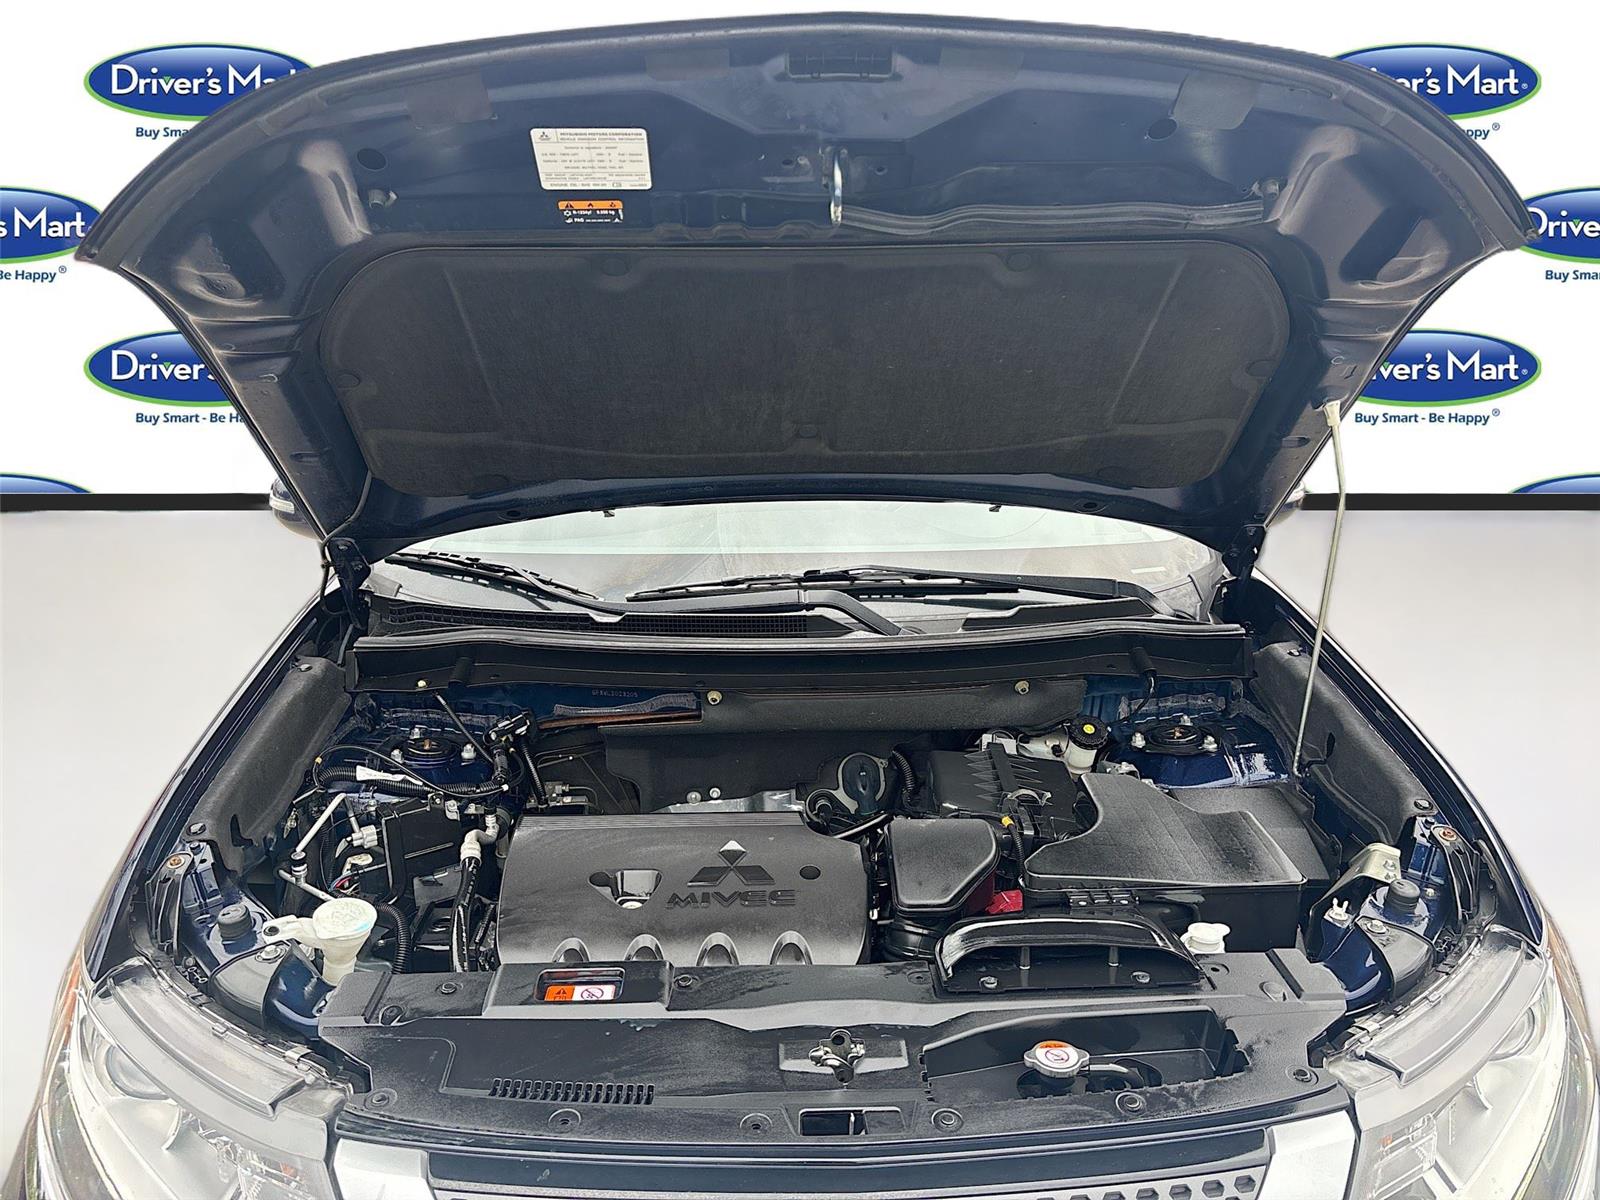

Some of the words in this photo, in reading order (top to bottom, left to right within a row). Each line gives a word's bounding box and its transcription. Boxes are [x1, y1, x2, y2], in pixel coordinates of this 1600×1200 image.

[111, 64, 221, 95] Driver's
[1447, 64, 1519, 94] Mart
[136, 127, 160, 140] Buy
[163, 127, 189, 138] Sma
[14, 206, 86, 238] Mart
[1528, 206, 1600, 238] Drive
[1545, 270, 1570, 283] Buy
[1572, 270, 1600, 280] Sma
[111, 350, 215, 380] Driver
[1372, 352, 1441, 380] ver's
[1447, 349, 1519, 380] Mart
[136, 413, 160, 425] Buy
[163, 413, 200, 423] Smart
[210, 413, 225, 423] Be
[1354, 413, 1379, 426] Buy
[1382, 413, 1418, 423] Smart
[1429, 413, 1445, 423] Be
[666, 889, 796, 908] MIVEC
